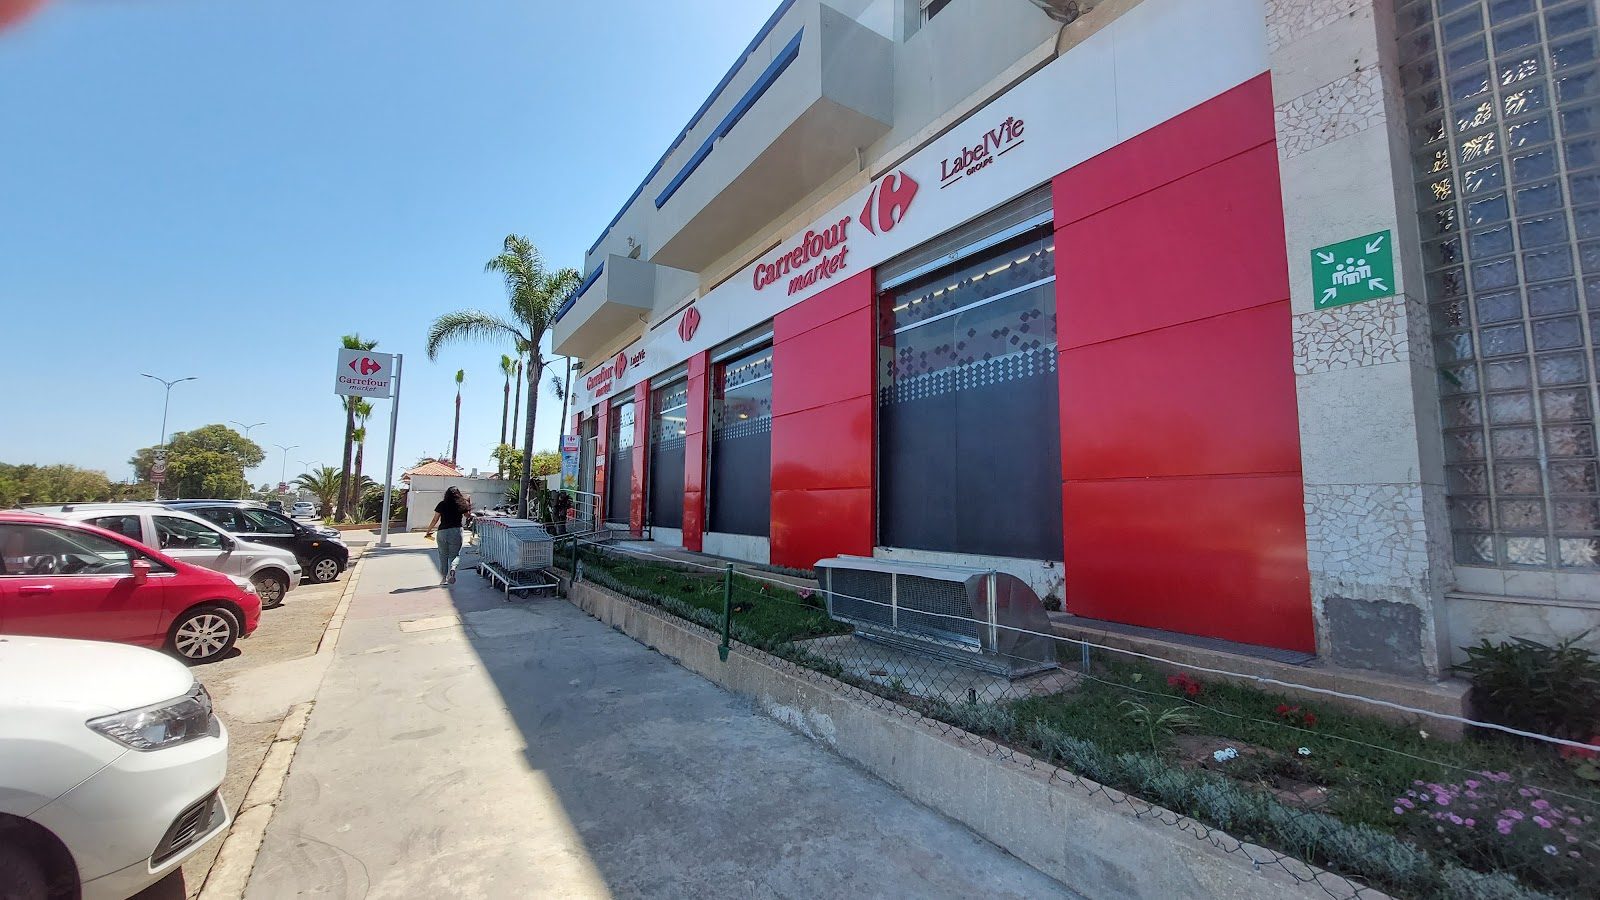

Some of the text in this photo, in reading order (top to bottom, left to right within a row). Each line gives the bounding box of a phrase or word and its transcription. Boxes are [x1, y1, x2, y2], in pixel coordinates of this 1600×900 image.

[940, 117, 1024, 181] LabelVie
[966, 155, 993, 175] GROUPE
[753, 215, 851, 290] Carrefour
[787, 245, 849, 296] market
[338, 375, 389, 387] Carrefour
[587, 366, 613, 390] Carrefour
